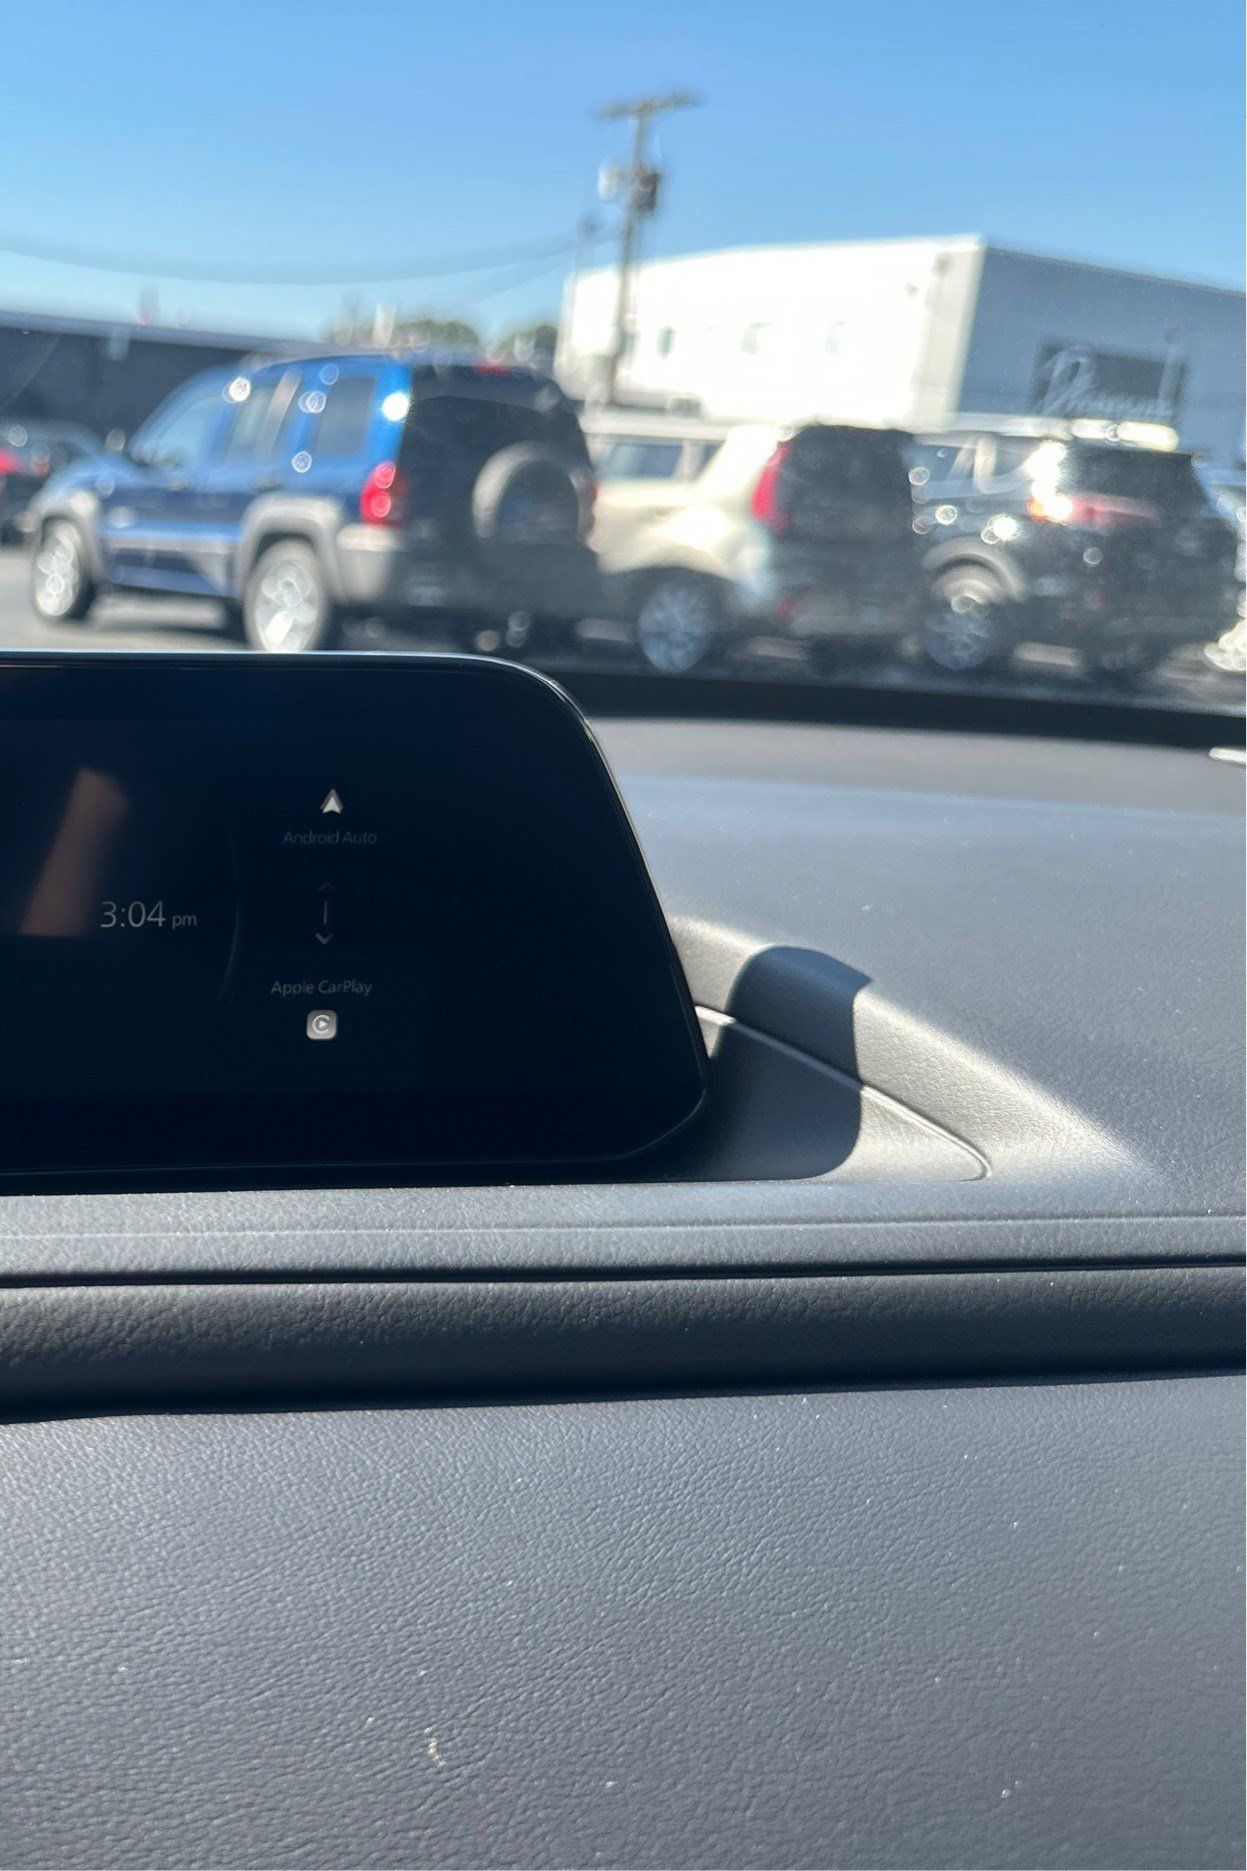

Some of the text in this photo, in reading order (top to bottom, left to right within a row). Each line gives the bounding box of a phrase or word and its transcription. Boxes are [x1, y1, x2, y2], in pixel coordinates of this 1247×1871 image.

[281, 829, 379, 846] Android Auto
[100, 899, 198, 931] 3:04 pm
[270, 978, 374, 999] Apple CarPlay
